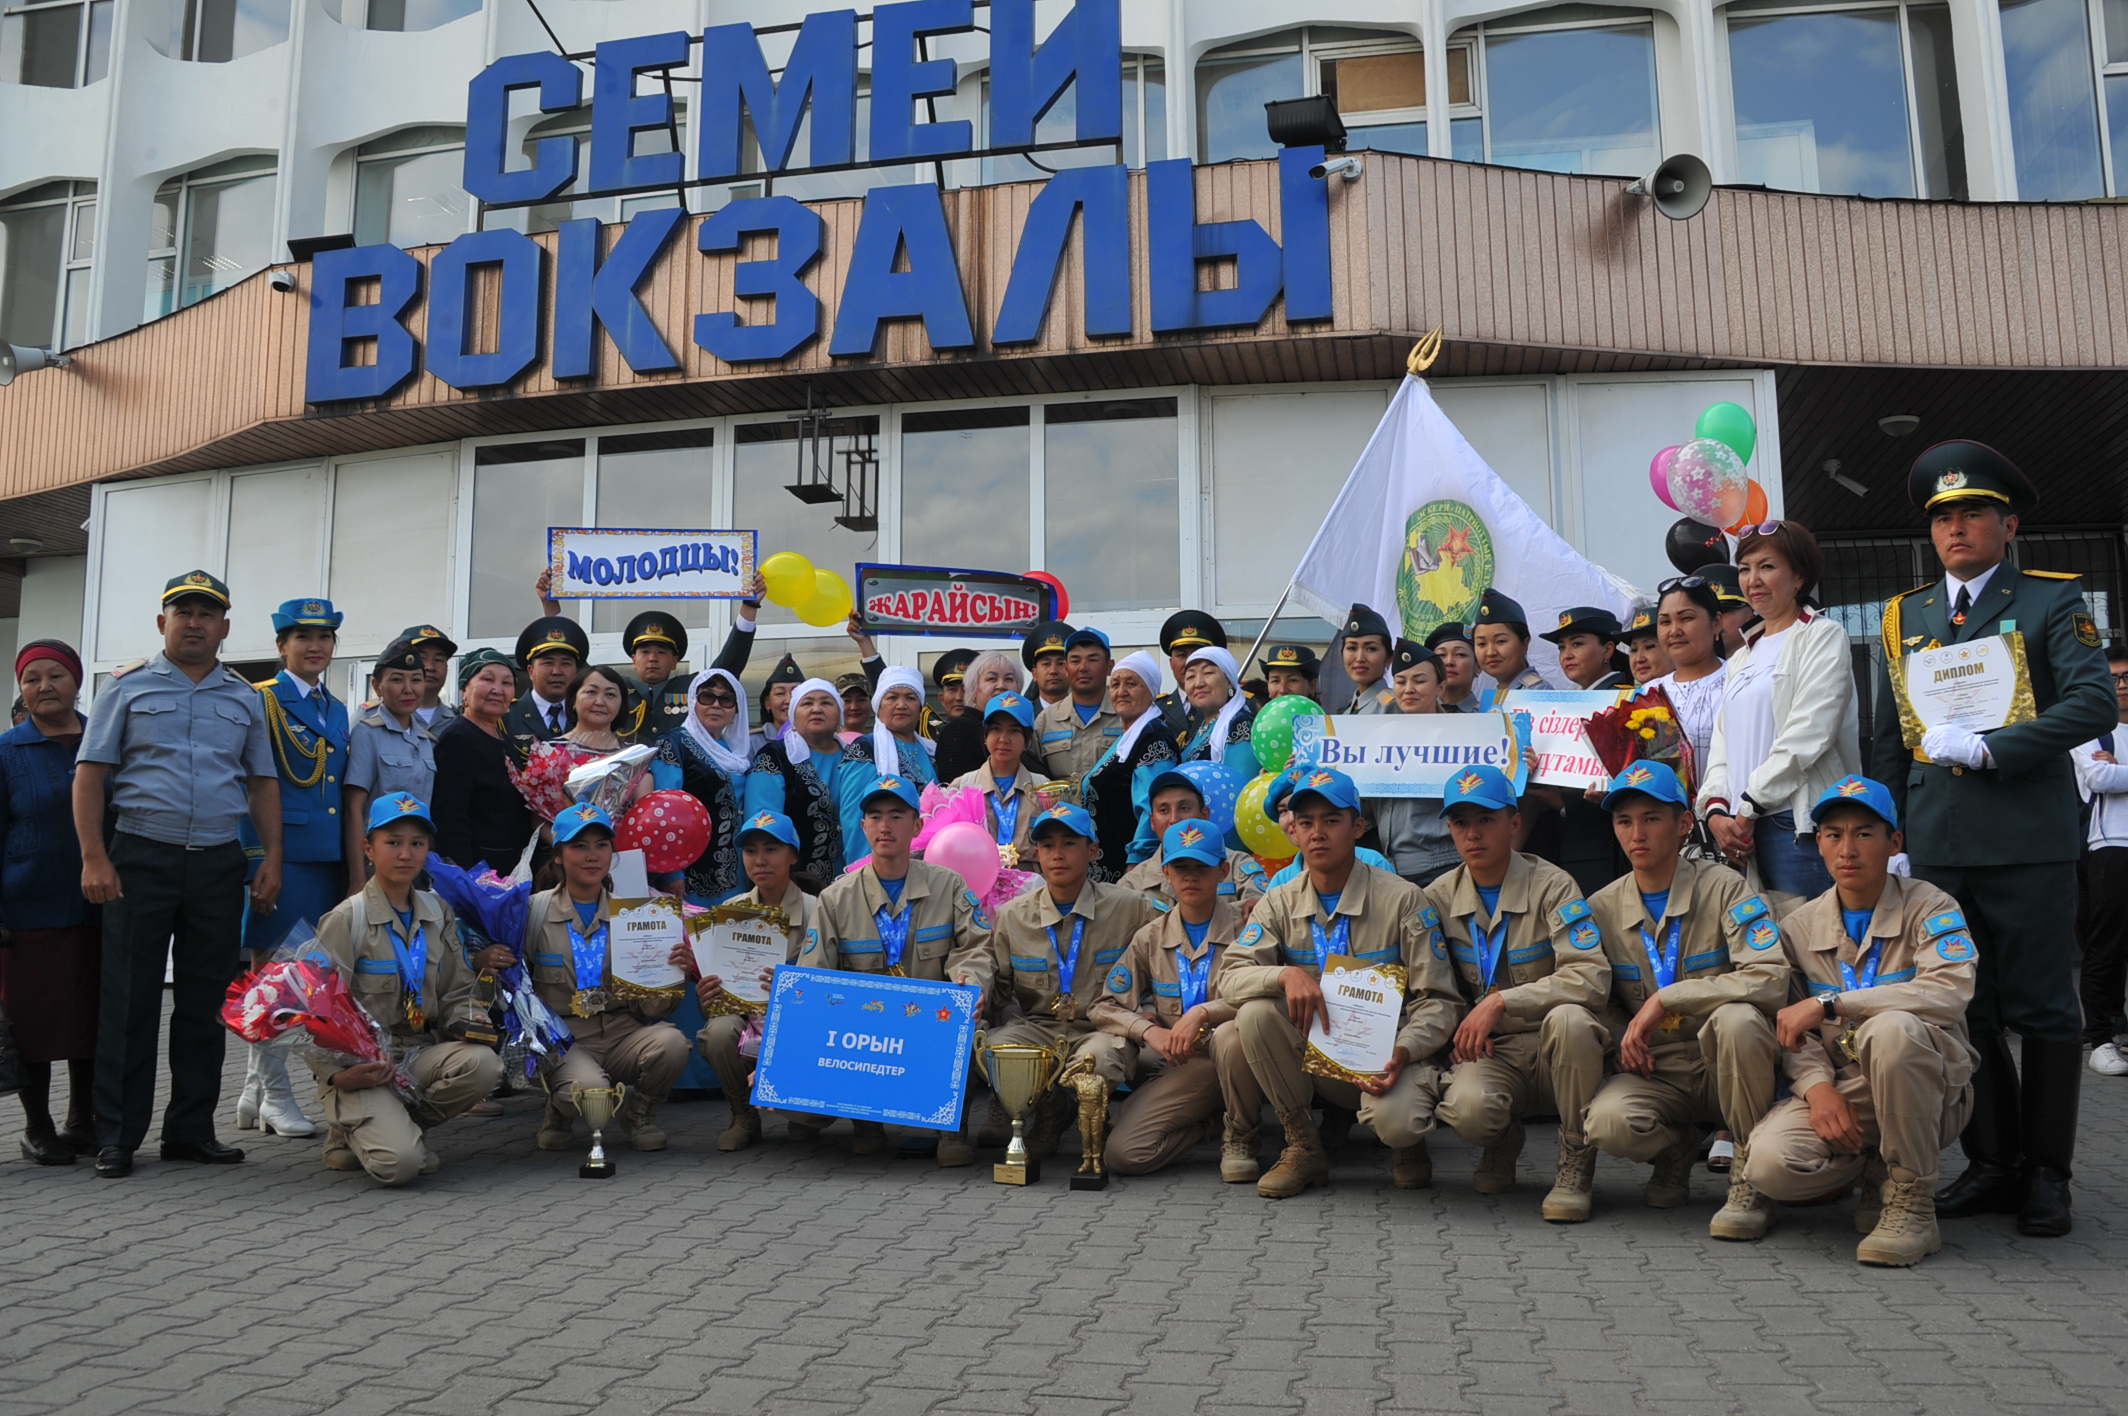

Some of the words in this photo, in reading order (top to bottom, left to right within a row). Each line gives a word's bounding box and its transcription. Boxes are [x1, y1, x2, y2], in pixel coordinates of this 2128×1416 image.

[305, 145, 1333, 404] ВОКЗАЛЫ
[567, 542, 739, 586] МОЛОДЦЫ!
[1933, 662, 1985, 684] ДИПЛОМ
[1539, 709, 1592, 742] сіздер
[1320, 738, 1367, 764] Вы
[1375, 737, 1509, 771] лучшие!
[627, 920, 667, 932] ГРАМОТА
[732, 932, 772, 946] ГРАМОТА
[1337, 984, 1384, 1004] ГРАМОТА
[842, 1032, 904, 1055] ОРЫН
[817, 1057, 906, 1077] ВЕЛОСИПЕДТЕР
